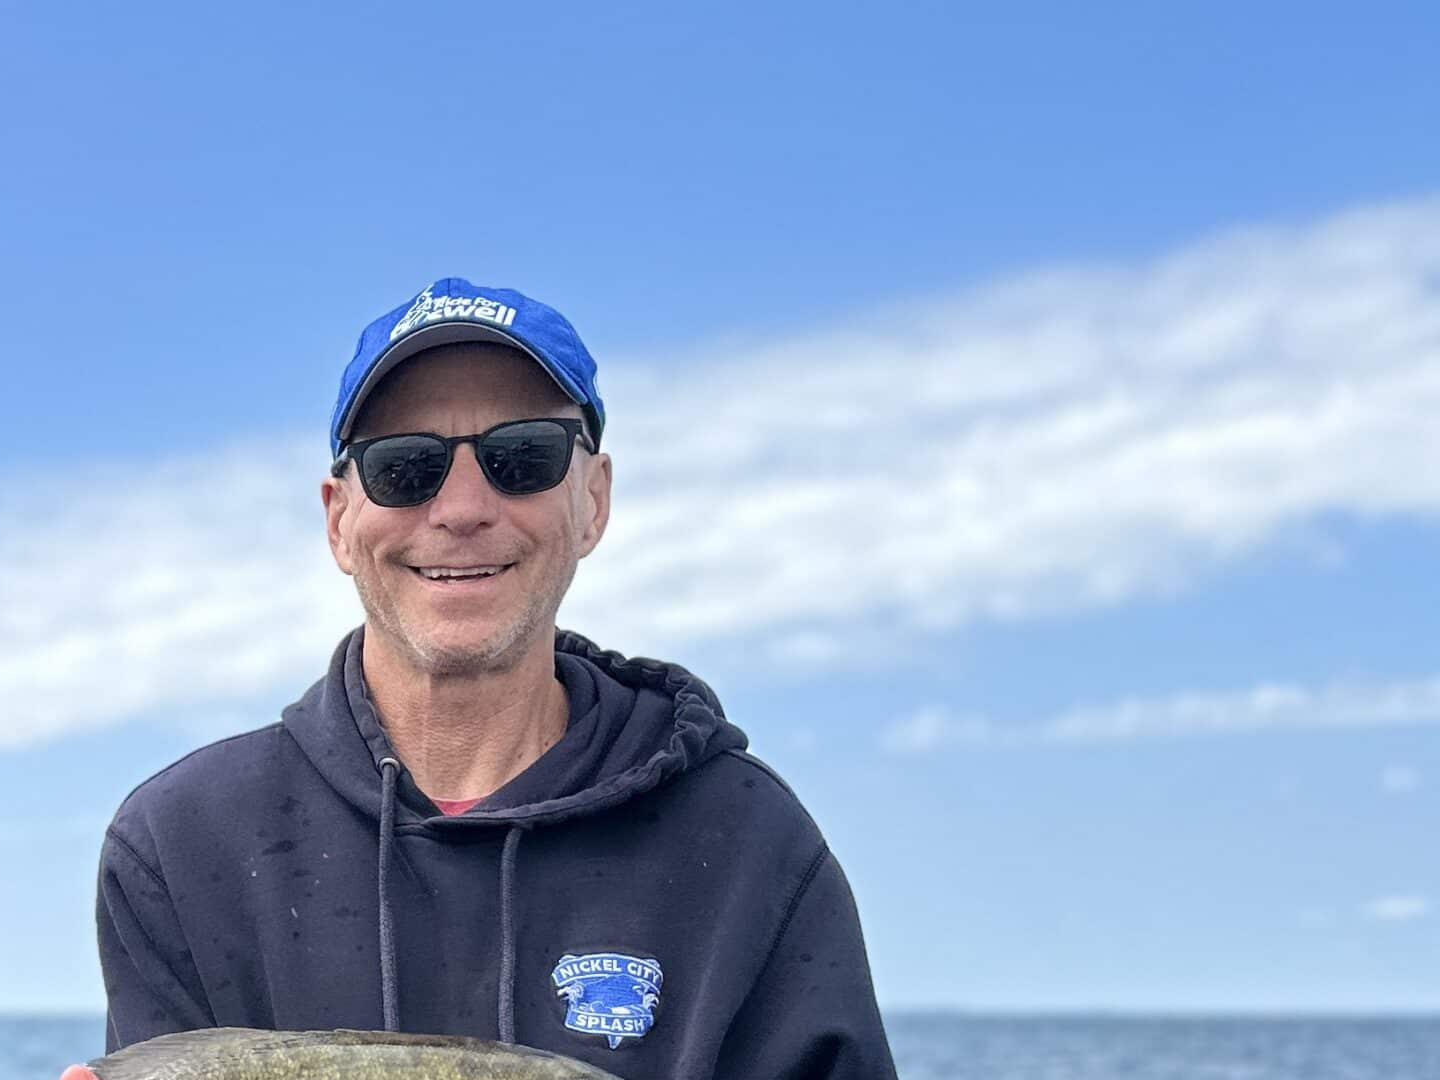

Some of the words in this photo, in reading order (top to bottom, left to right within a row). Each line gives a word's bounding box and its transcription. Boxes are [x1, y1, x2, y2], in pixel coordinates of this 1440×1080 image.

[560, 959, 622, 978] NICKEL
[626, 963, 660, 983] CITY
[575, 1014, 645, 1032] SPLASH
